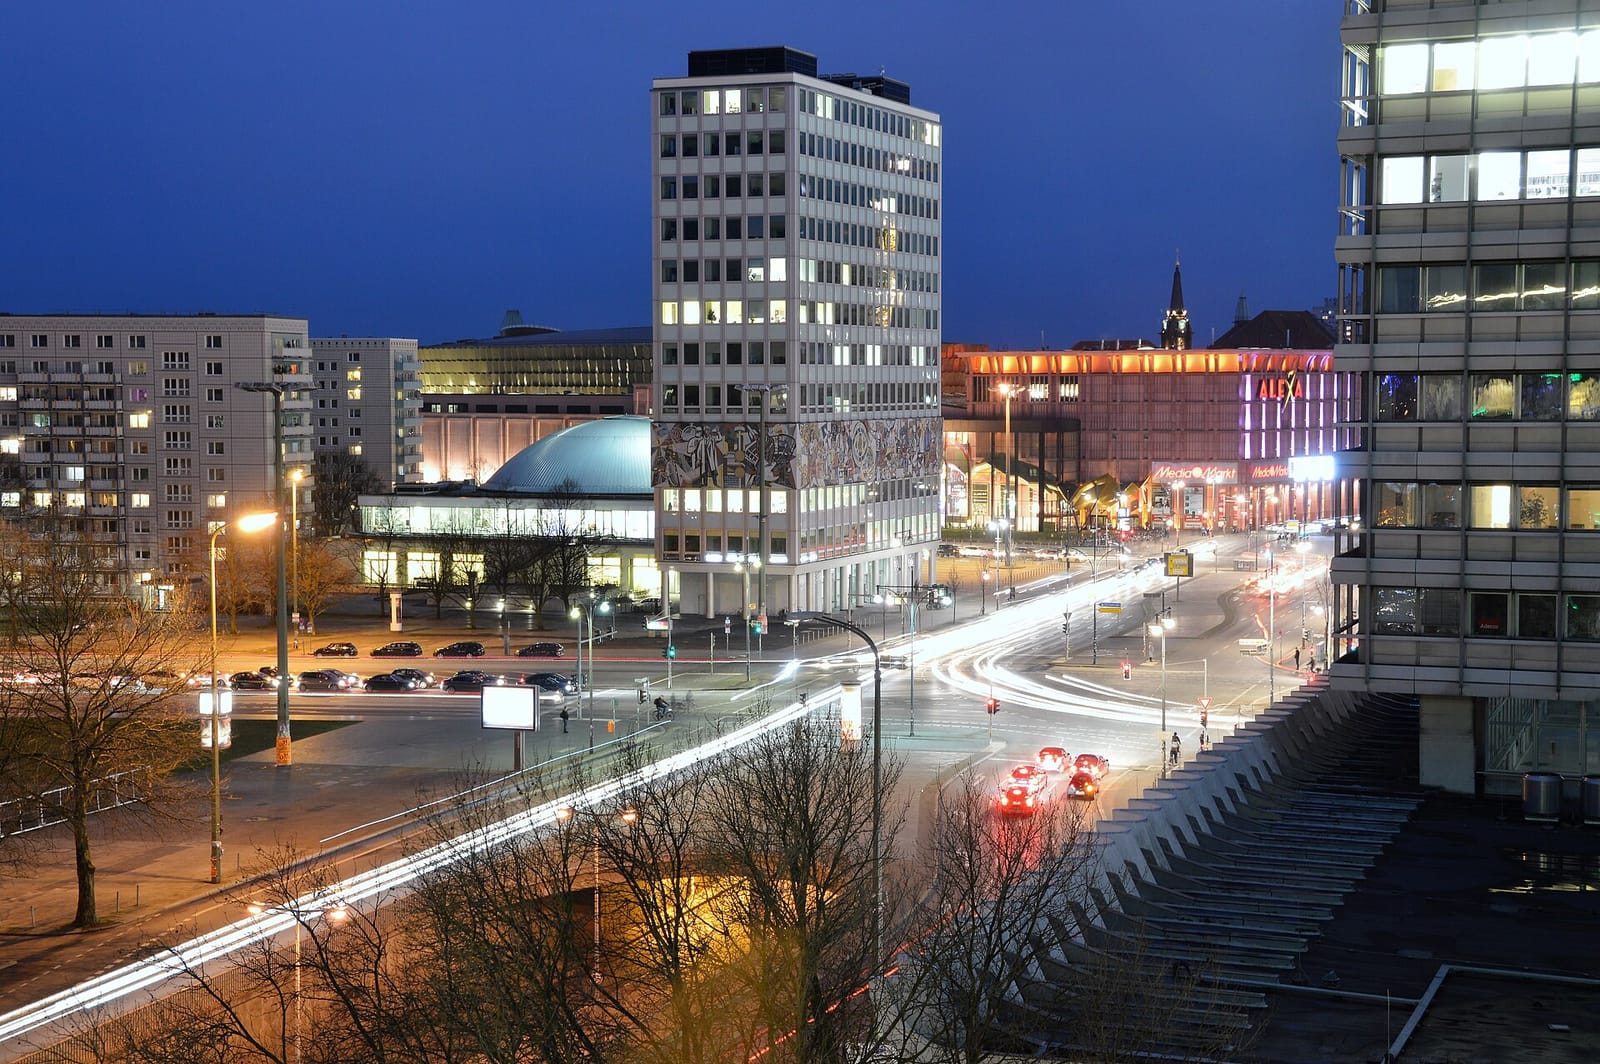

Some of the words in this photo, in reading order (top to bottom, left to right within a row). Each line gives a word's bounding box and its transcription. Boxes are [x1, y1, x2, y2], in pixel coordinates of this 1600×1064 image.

[1259, 370, 1304, 413] ALEXA
[1154, 465, 1192, 479] Media
[1202, 466, 1237, 480] Markt
